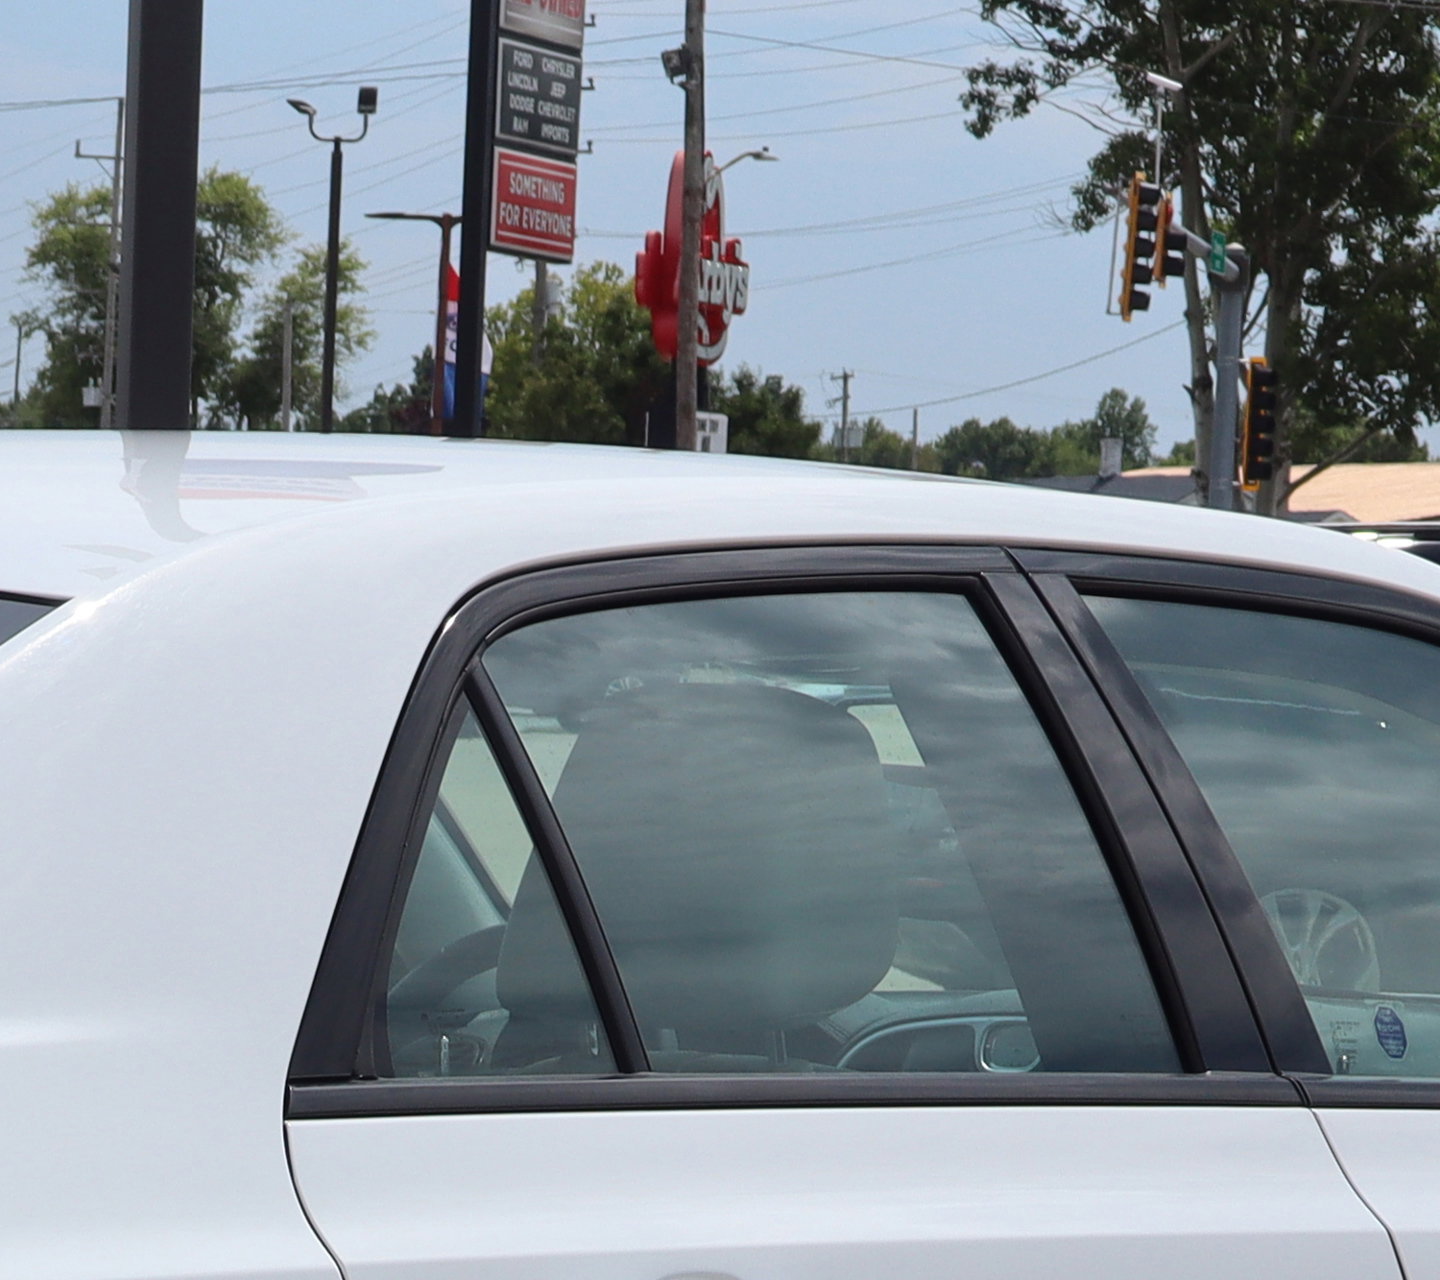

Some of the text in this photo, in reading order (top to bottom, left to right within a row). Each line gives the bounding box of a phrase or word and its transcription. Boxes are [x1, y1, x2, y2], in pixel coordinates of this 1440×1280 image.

[513, 50, 575, 79] FORD CHRYSLER
[508, 71, 566, 98] LINCOLN JEEP
[509, 93, 576, 121] DODGE CHEVROLET
[513, 115, 570, 143] RAM IMPORTS
[510, 171, 565, 205] SOMETHING
[500, 201, 573, 238] FOR EVERYONE
